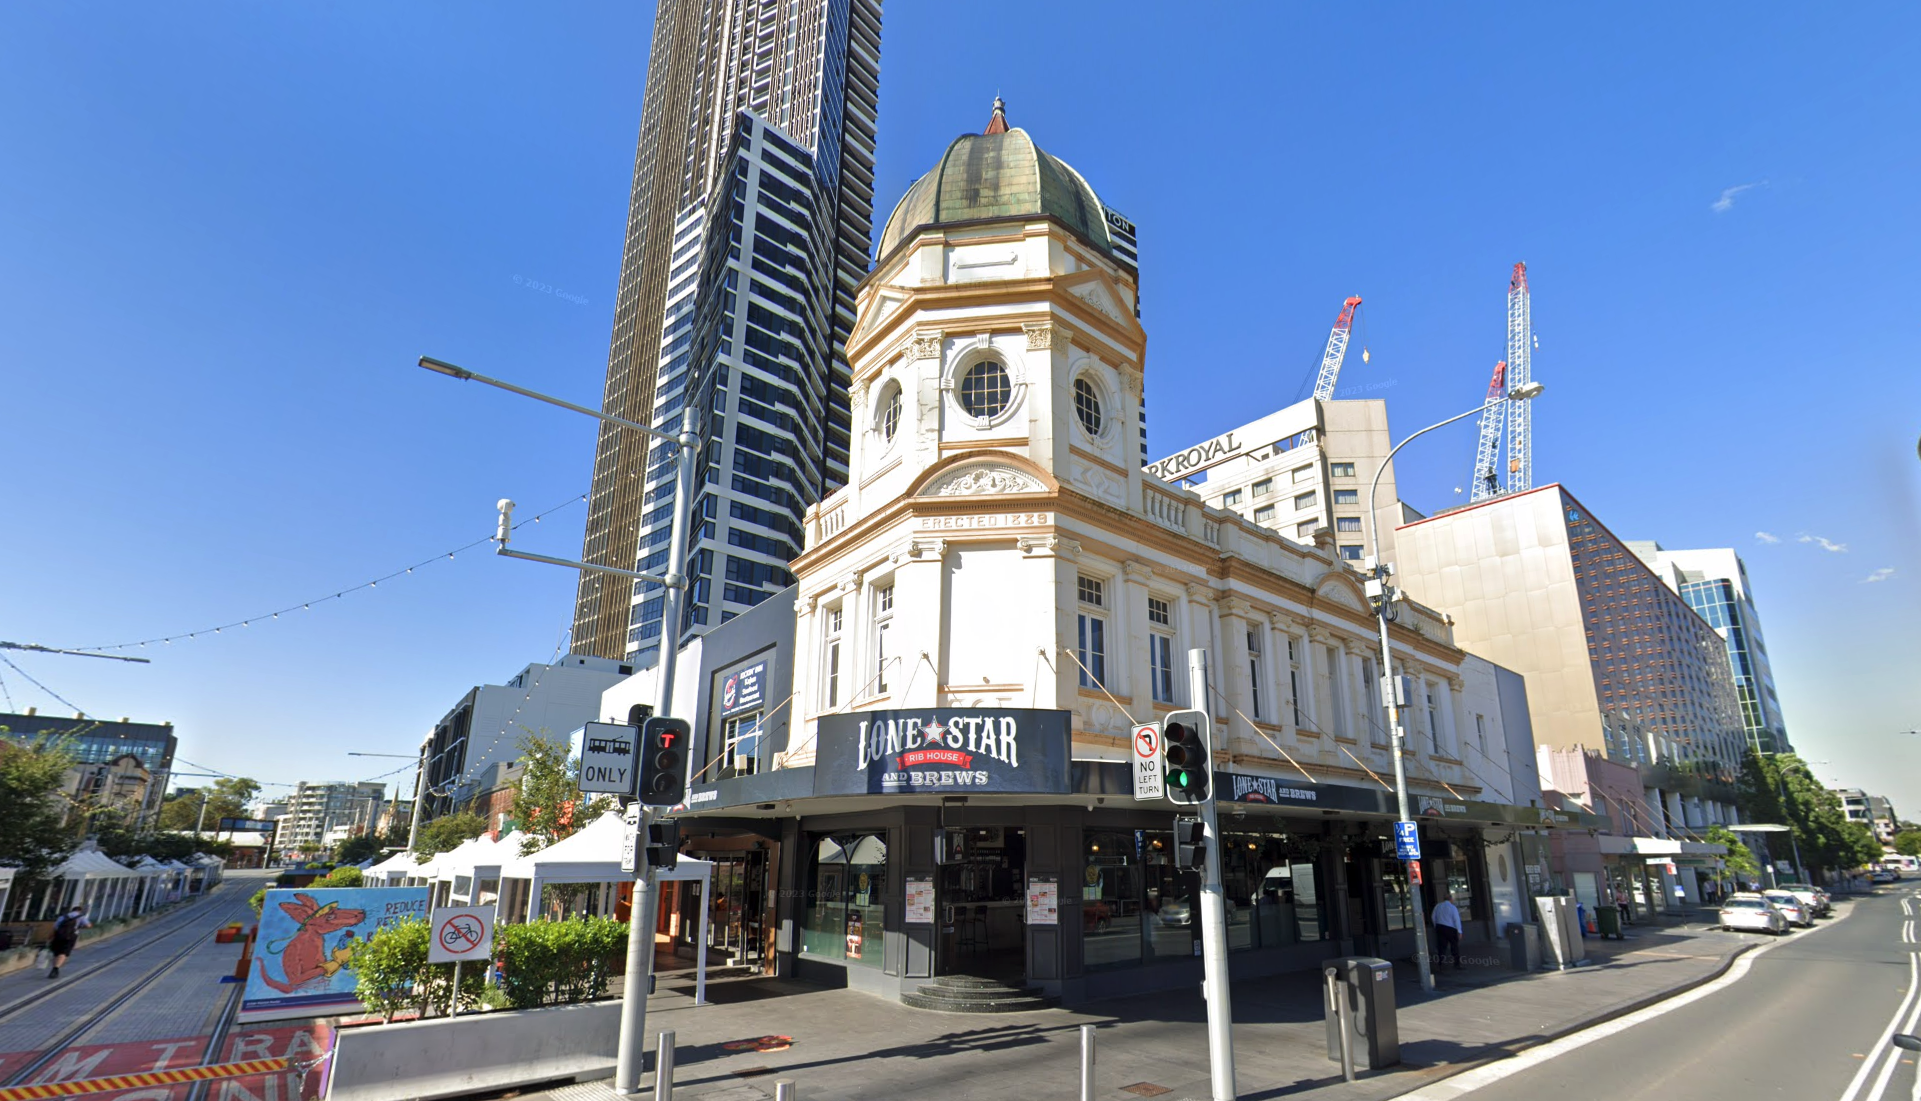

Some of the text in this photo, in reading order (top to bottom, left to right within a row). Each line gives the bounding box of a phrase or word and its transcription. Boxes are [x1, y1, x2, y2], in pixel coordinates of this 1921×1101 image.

[921, 513, 1048, 529] ERECTED 1889
[856, 715, 1018, 771] LONE STAR
[909, 752, 959, 763] RIB HOUSE
[585, 766, 627, 783] ONLY
[1140, 760, 1155, 773] NO
[881, 770, 989, 787] AND BREWS
[1138, 774, 1158, 784] LEFT
[1138, 786, 1160, 795] TURN
[1232, 775, 1278, 803] LONE STAR
[1290, 788, 1317, 801] BREWS
[384, 899, 426, 916] REDUCE
